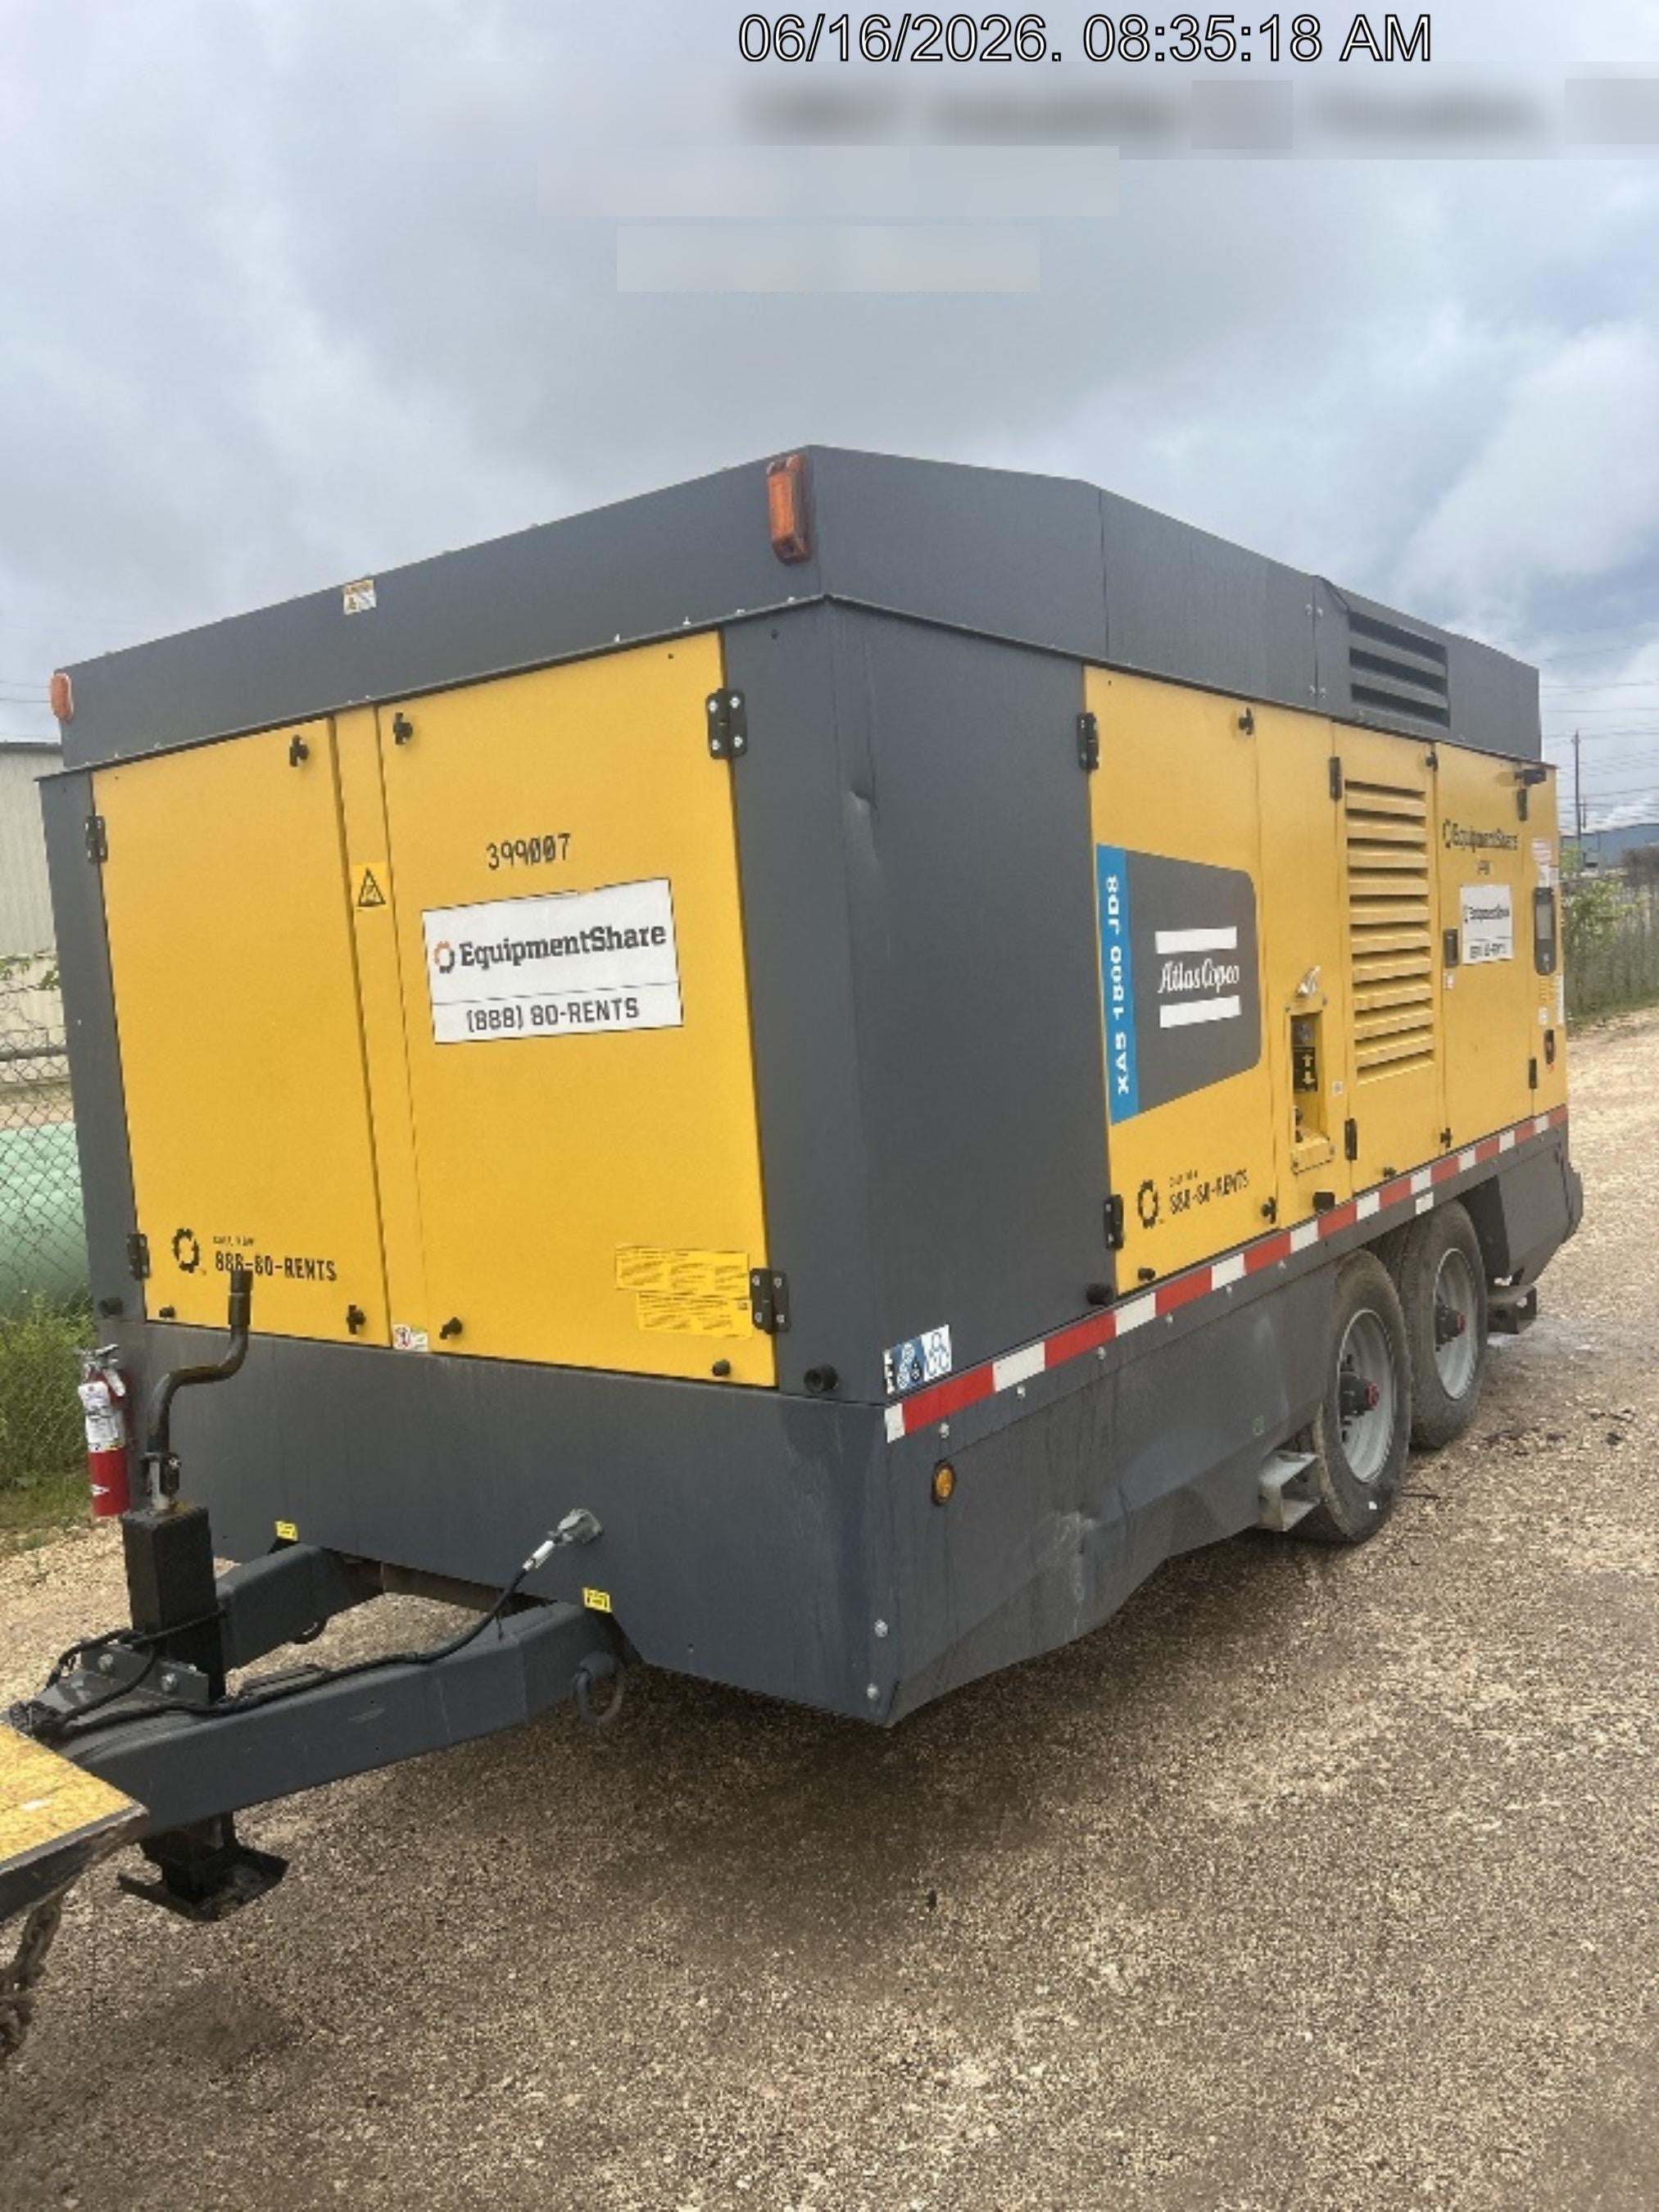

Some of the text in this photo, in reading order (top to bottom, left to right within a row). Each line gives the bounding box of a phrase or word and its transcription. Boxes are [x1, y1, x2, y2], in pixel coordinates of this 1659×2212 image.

[486, 832, 571, 871] 399007
[460, 925, 666, 970] EquipmentShare
[1110, 945, 1125, 1021] 1800
[1157, 958, 1240, 994] Atlas Copco
[466, 997, 640, 1033] (888) 80-RENTS
[1115, 1031, 1129, 1095] XAS
[215, 1251, 338, 1281] 888-80-RENTS
